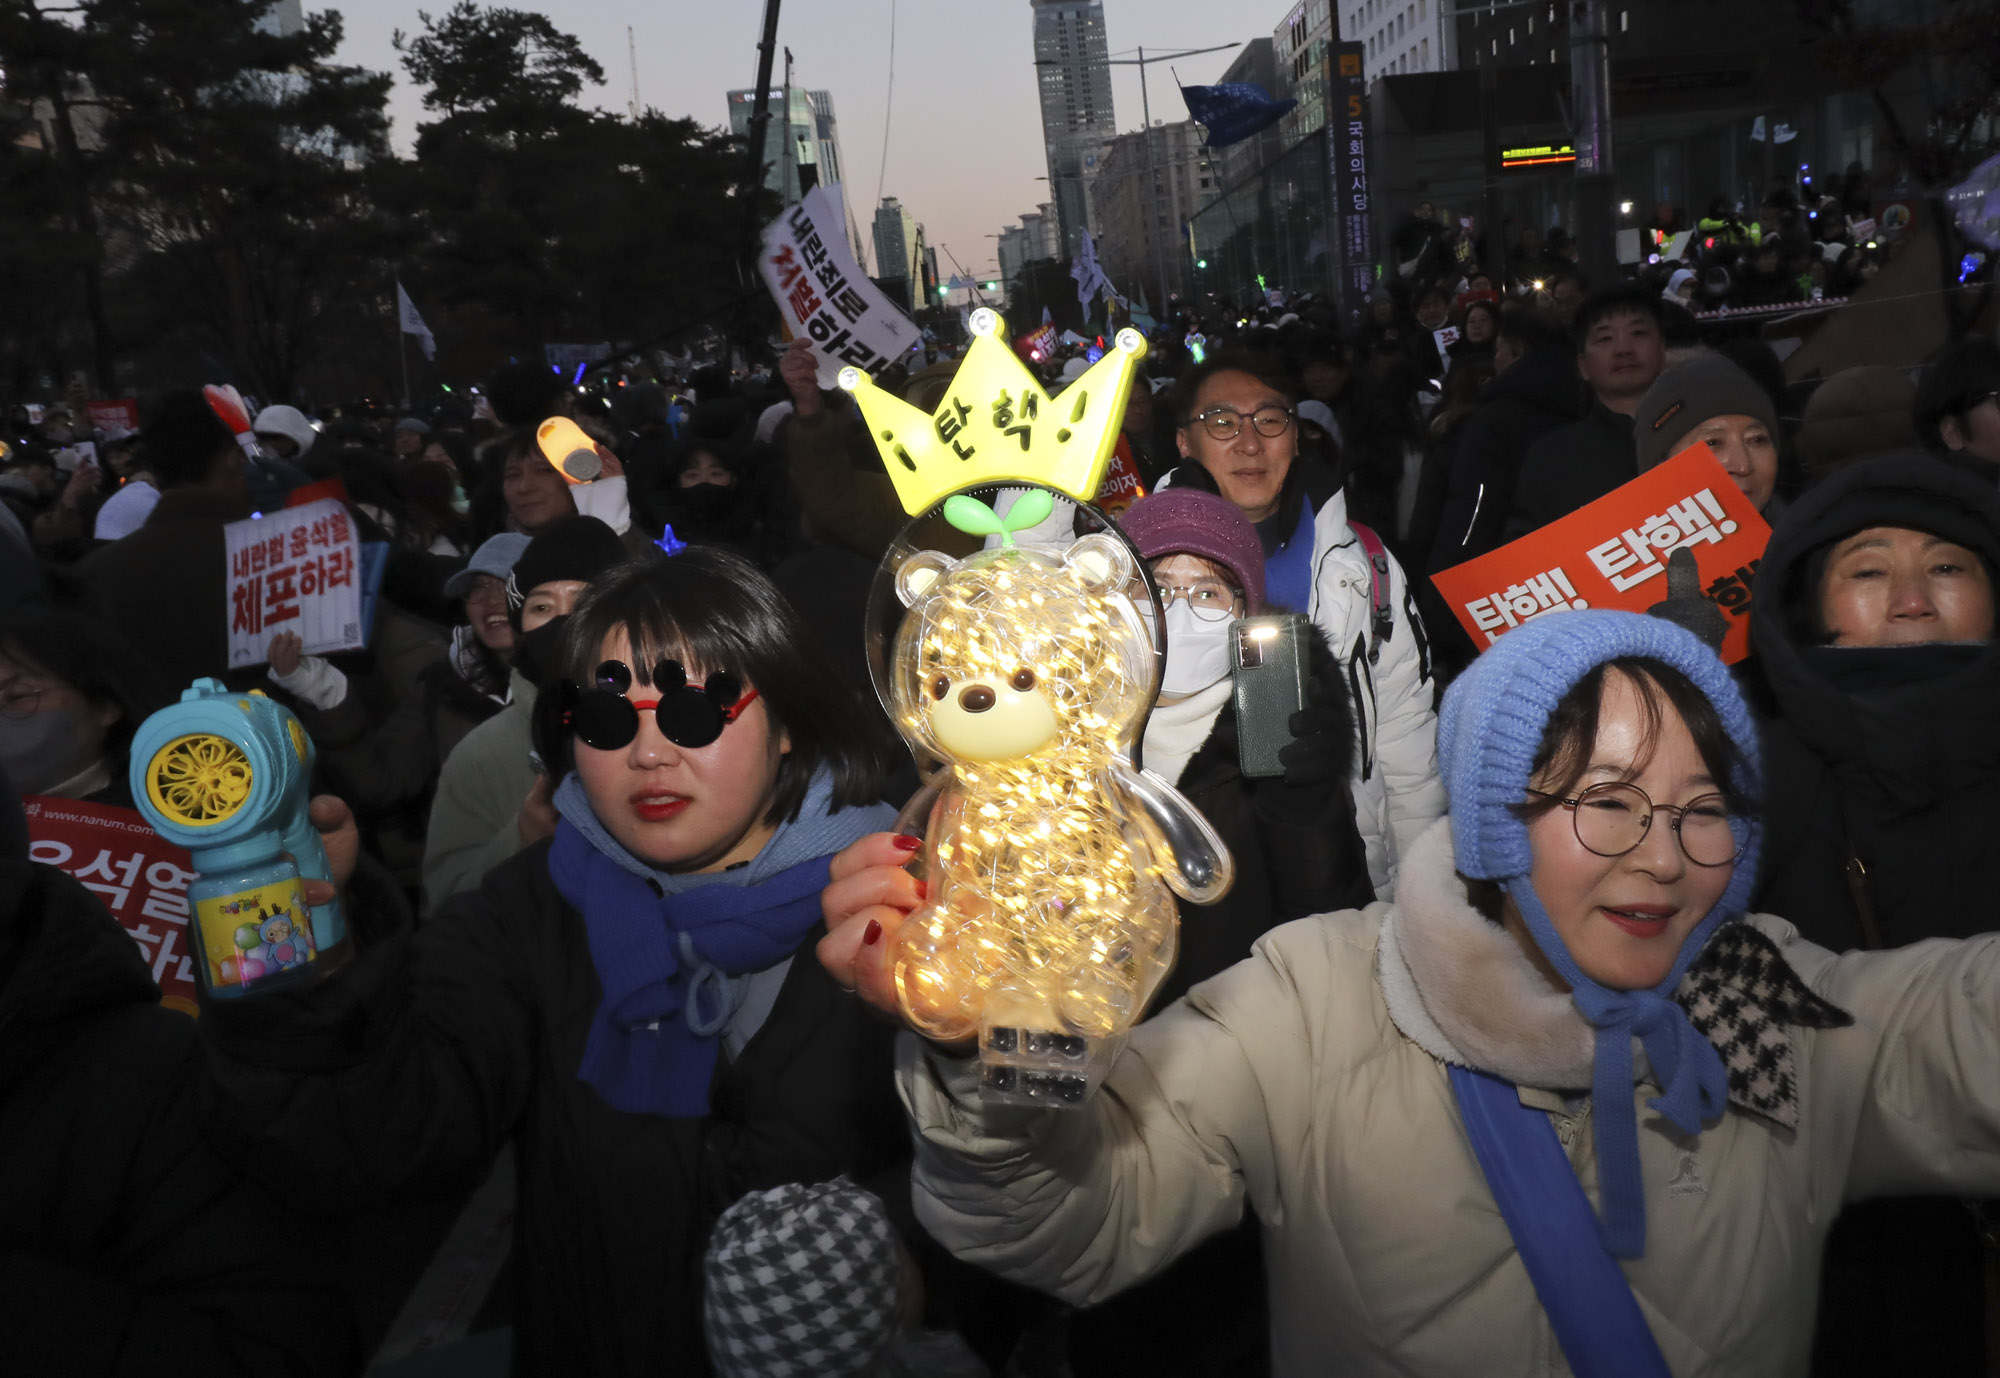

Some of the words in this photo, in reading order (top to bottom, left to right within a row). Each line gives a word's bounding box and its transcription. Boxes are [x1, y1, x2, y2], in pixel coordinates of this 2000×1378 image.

[1348, 95, 1363, 117] 5
[1349, 121, 1368, 211] 국회의사당
[790, 206, 870, 325] 내란죄로
[771, 244, 889, 377] 처벌하라
[233, 533, 284, 579] 내란범
[289, 512, 350, 558] 윤석열
[1586, 488, 1738, 593] 탄핵!
[233, 547, 354, 635] 체포하라
[1464, 567, 1589, 646] 탄핵!
[44, 810, 154, 836] www.nanum.com
